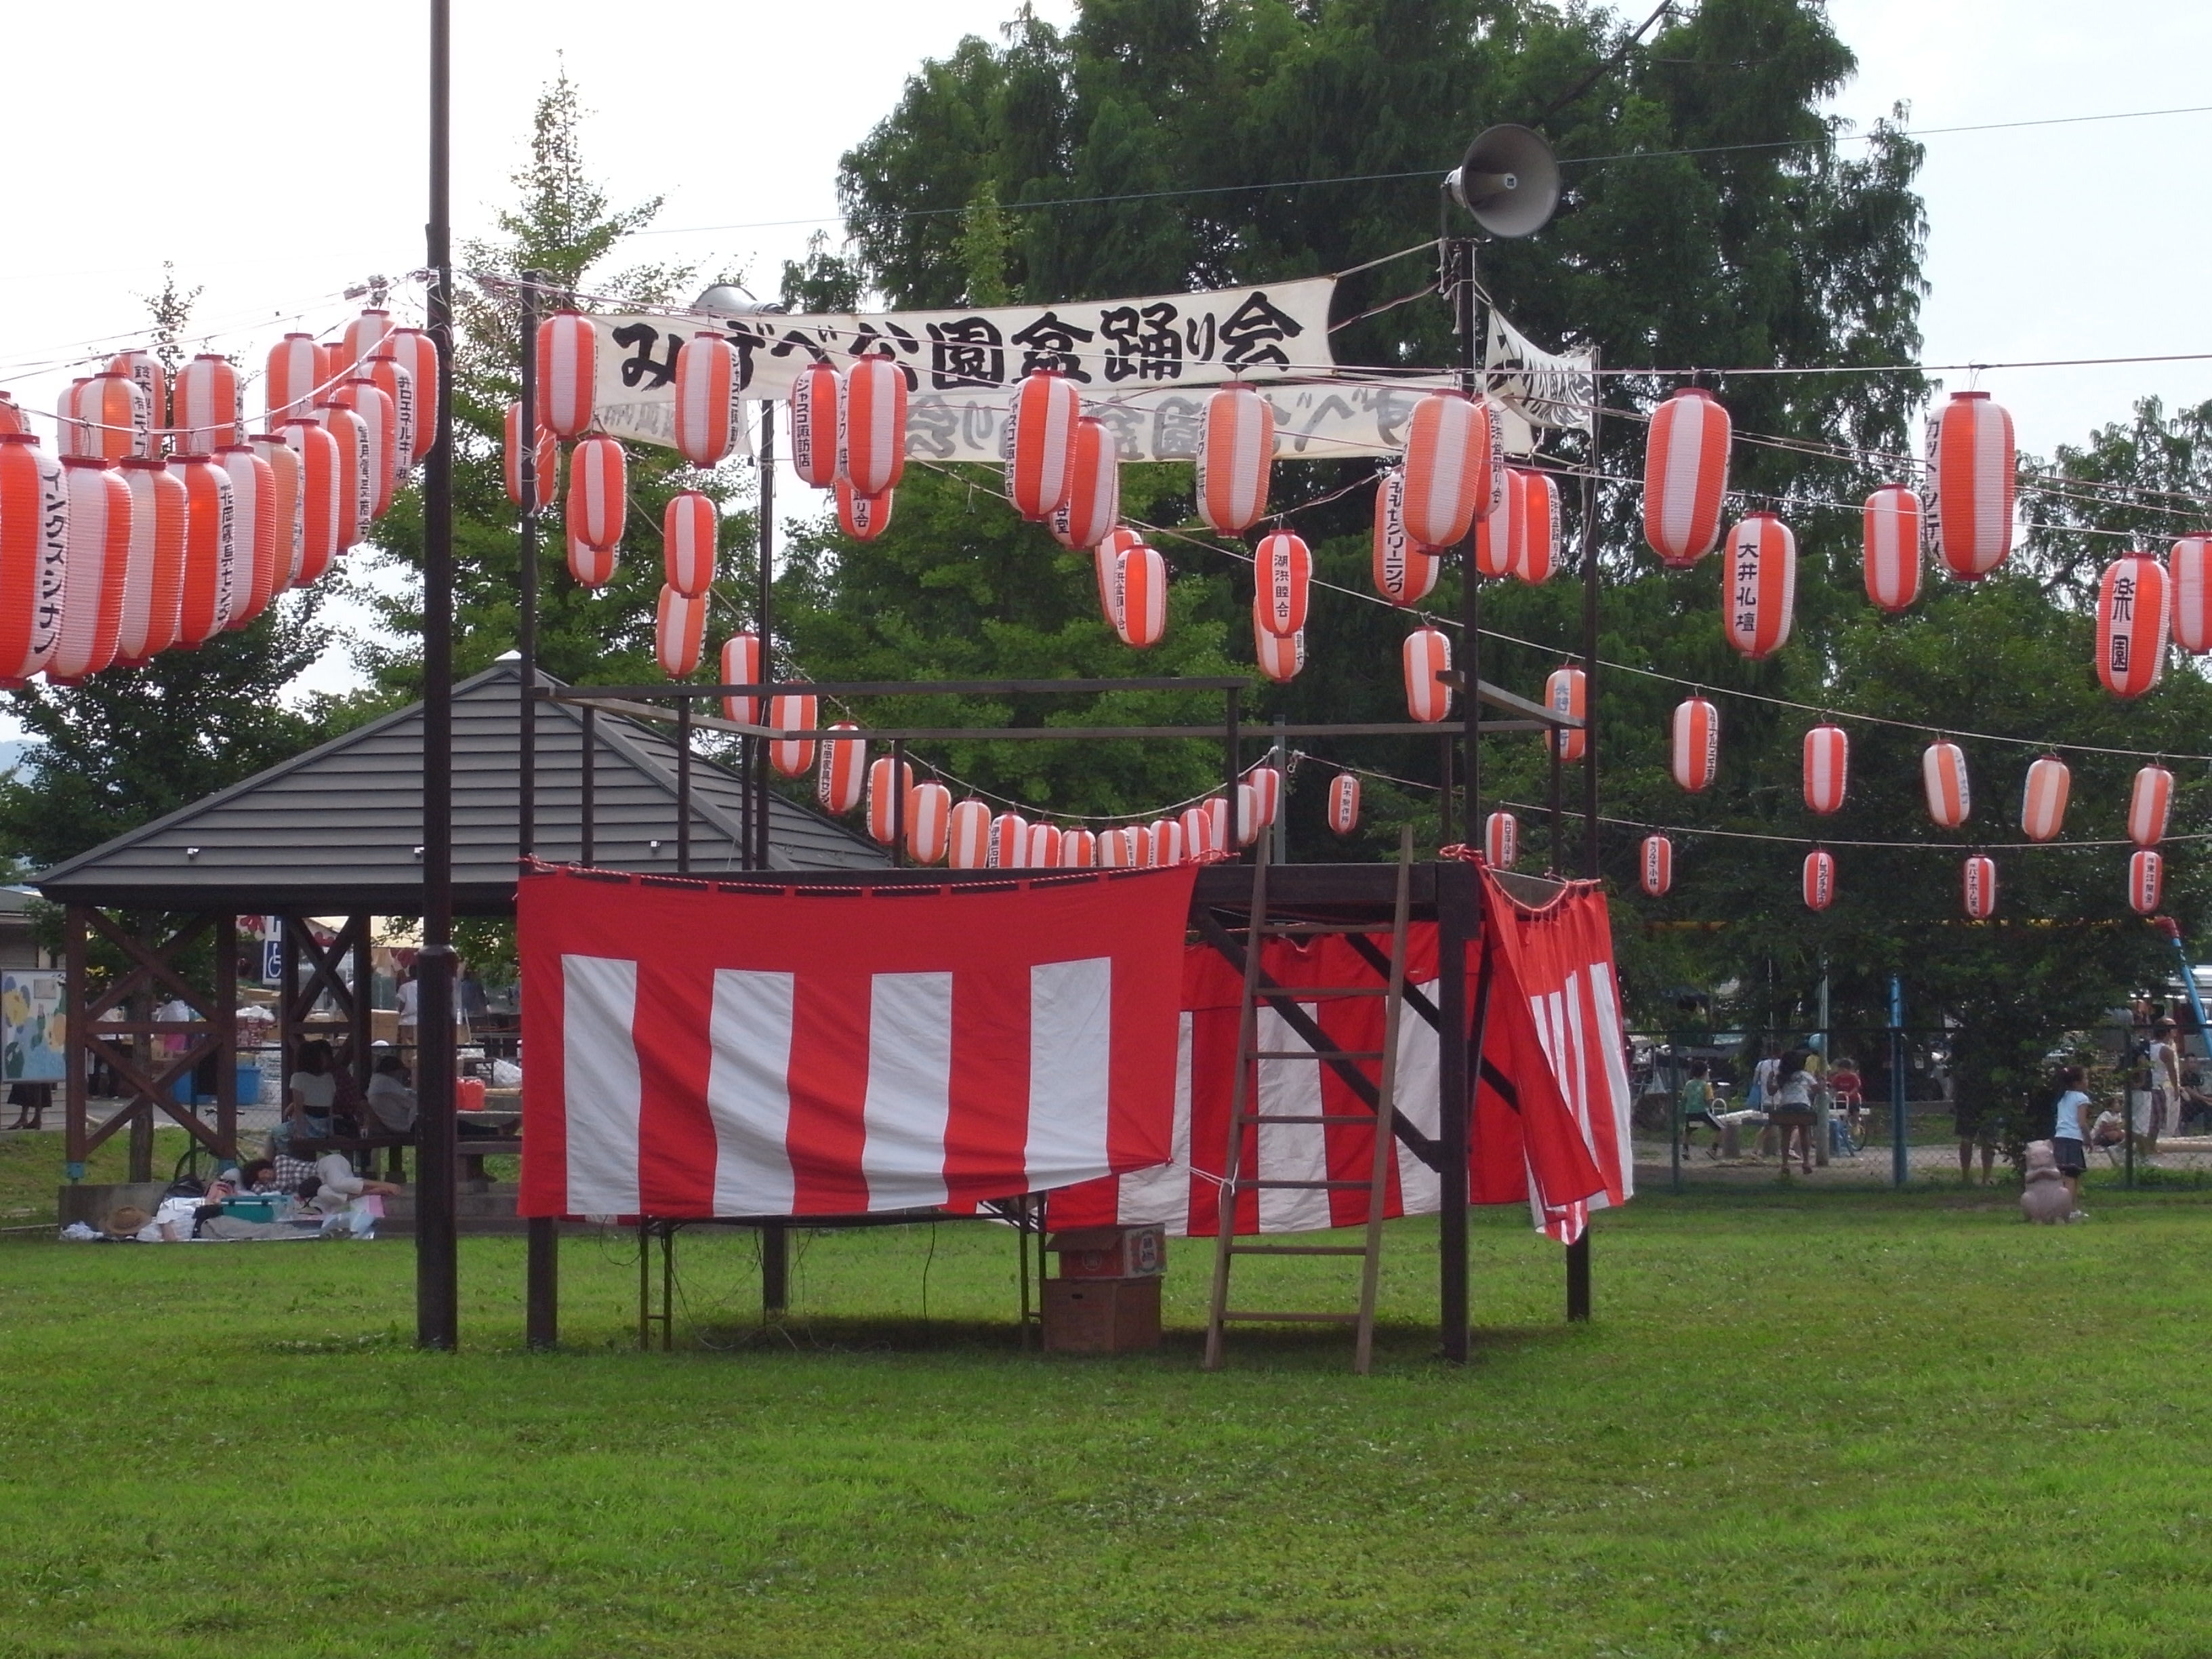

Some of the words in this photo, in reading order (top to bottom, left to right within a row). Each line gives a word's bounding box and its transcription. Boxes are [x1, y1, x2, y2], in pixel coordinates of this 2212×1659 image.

[795, 379, 811, 468] ジャスコ諏訪店
[1736, 542, 1758, 632] 大井仏壇
[2112, 577, 2135, 672] 楽園
